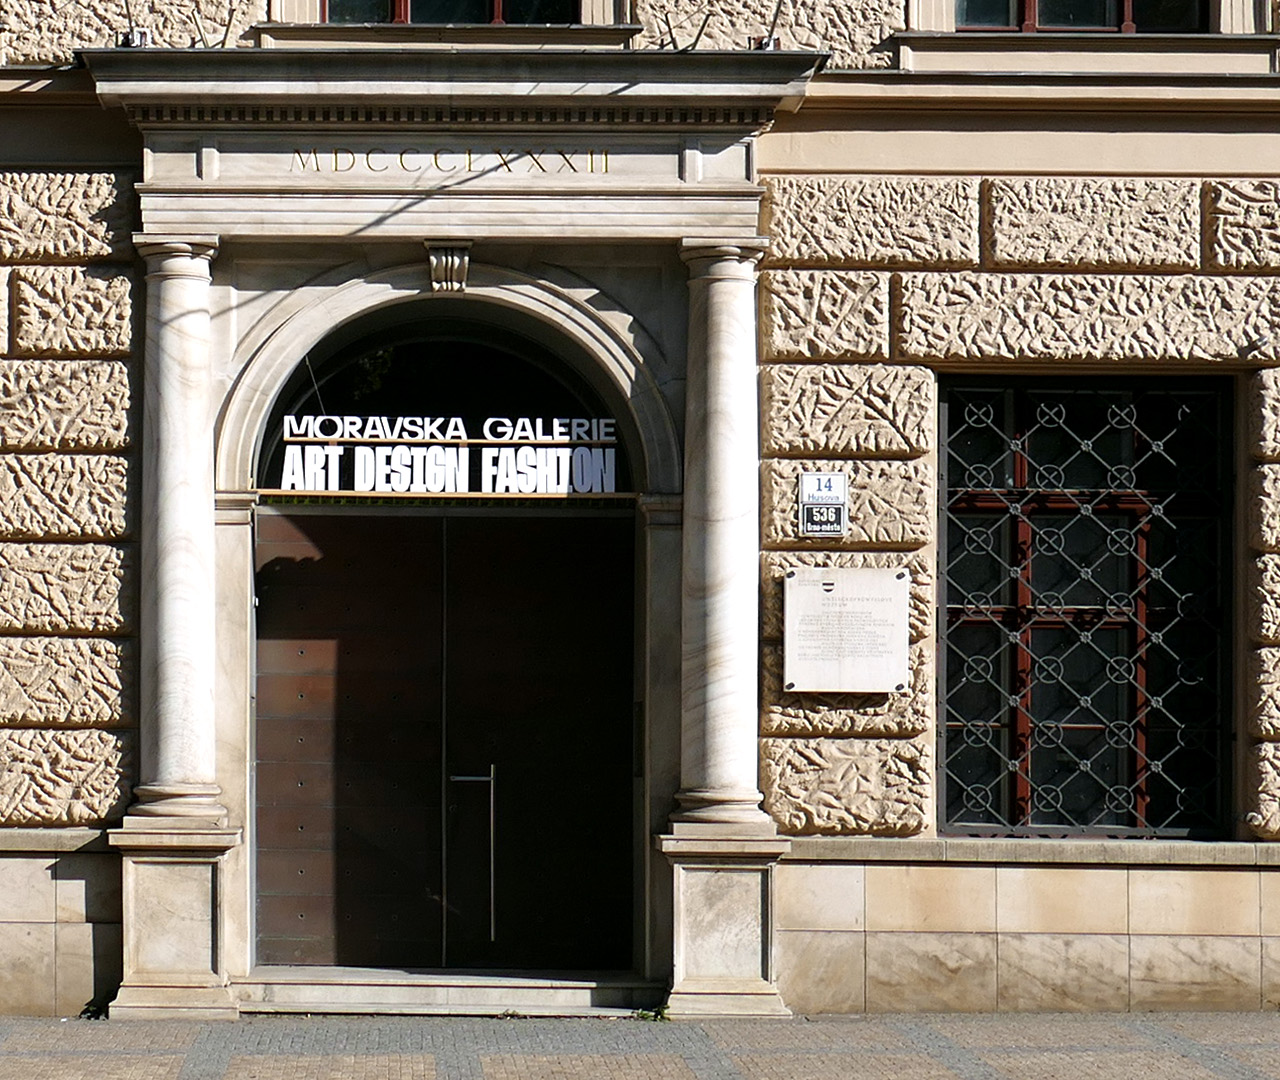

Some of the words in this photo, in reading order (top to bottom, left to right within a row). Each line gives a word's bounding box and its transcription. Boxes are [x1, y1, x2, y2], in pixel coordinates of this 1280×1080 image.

[289, 148, 610, 174] MDCCCLXXXII
[283, 415, 468, 441] MORAVSKA
[483, 417, 617, 442] GALERIE
[280, 444, 345, 492] ART
[354, 445, 470, 493] DESIGN
[481, 445, 617, 494] FASHION
[815, 477, 833, 492] 14
[807, 493, 840, 502] Husova
[812, 507, 836, 522] 536
